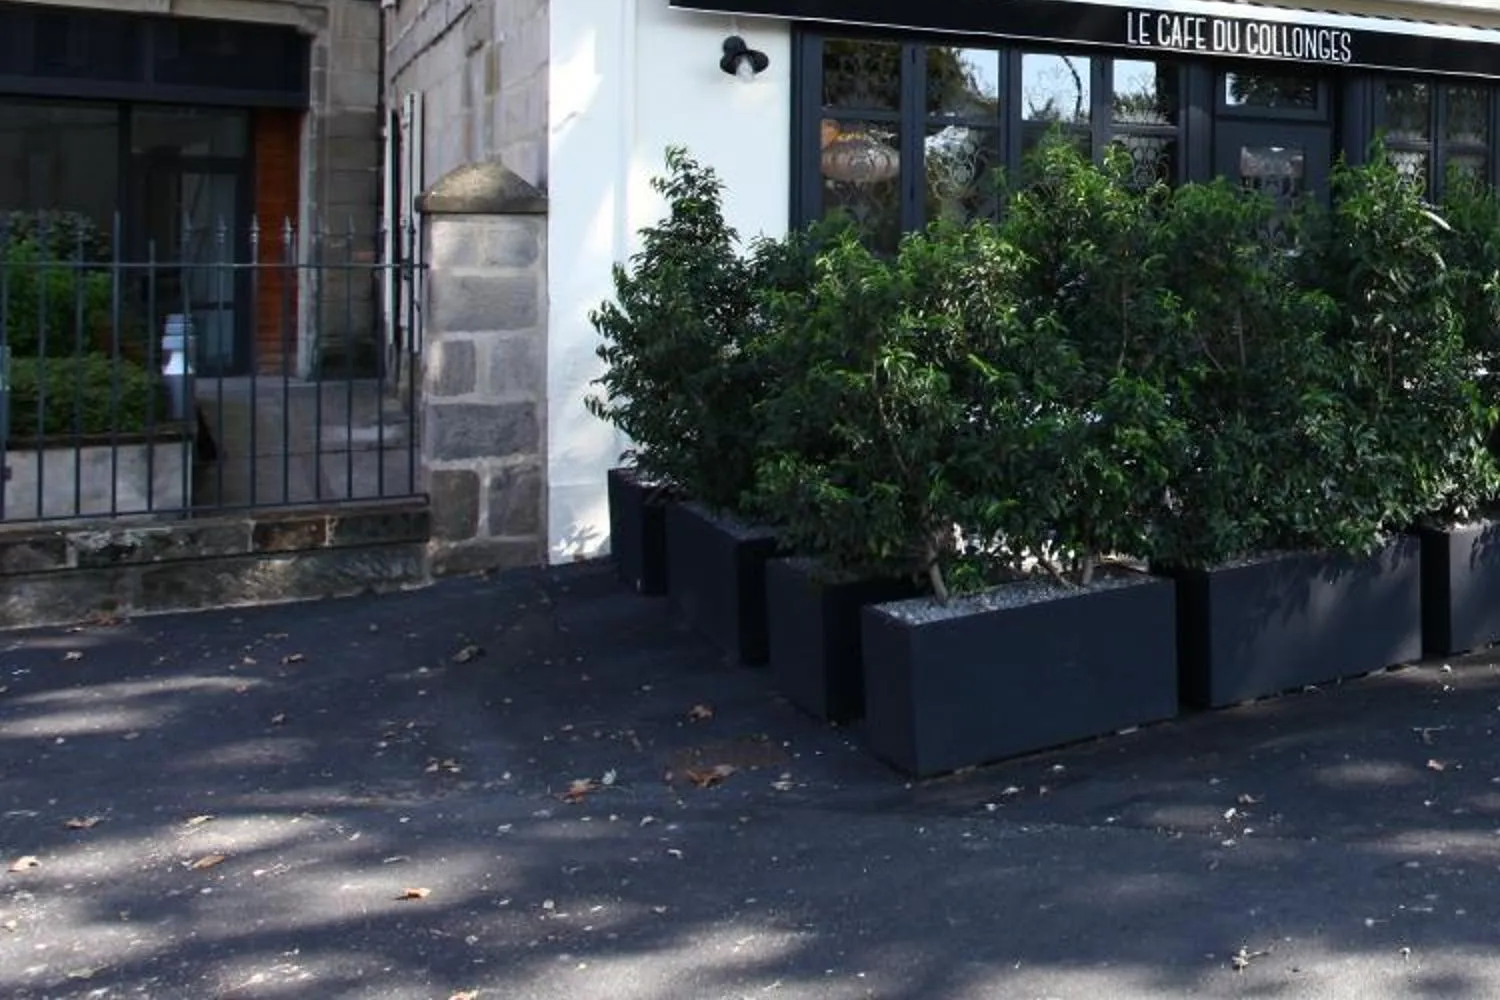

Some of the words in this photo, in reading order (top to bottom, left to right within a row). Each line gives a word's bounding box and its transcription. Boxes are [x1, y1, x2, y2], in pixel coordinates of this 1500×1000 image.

[1126, 11, 1150, 45] LE
[1157, 13, 1206, 50] CAFE
[1213, 19, 1239, 52] DU
[1246, 22, 1351, 63] COLLONGES
